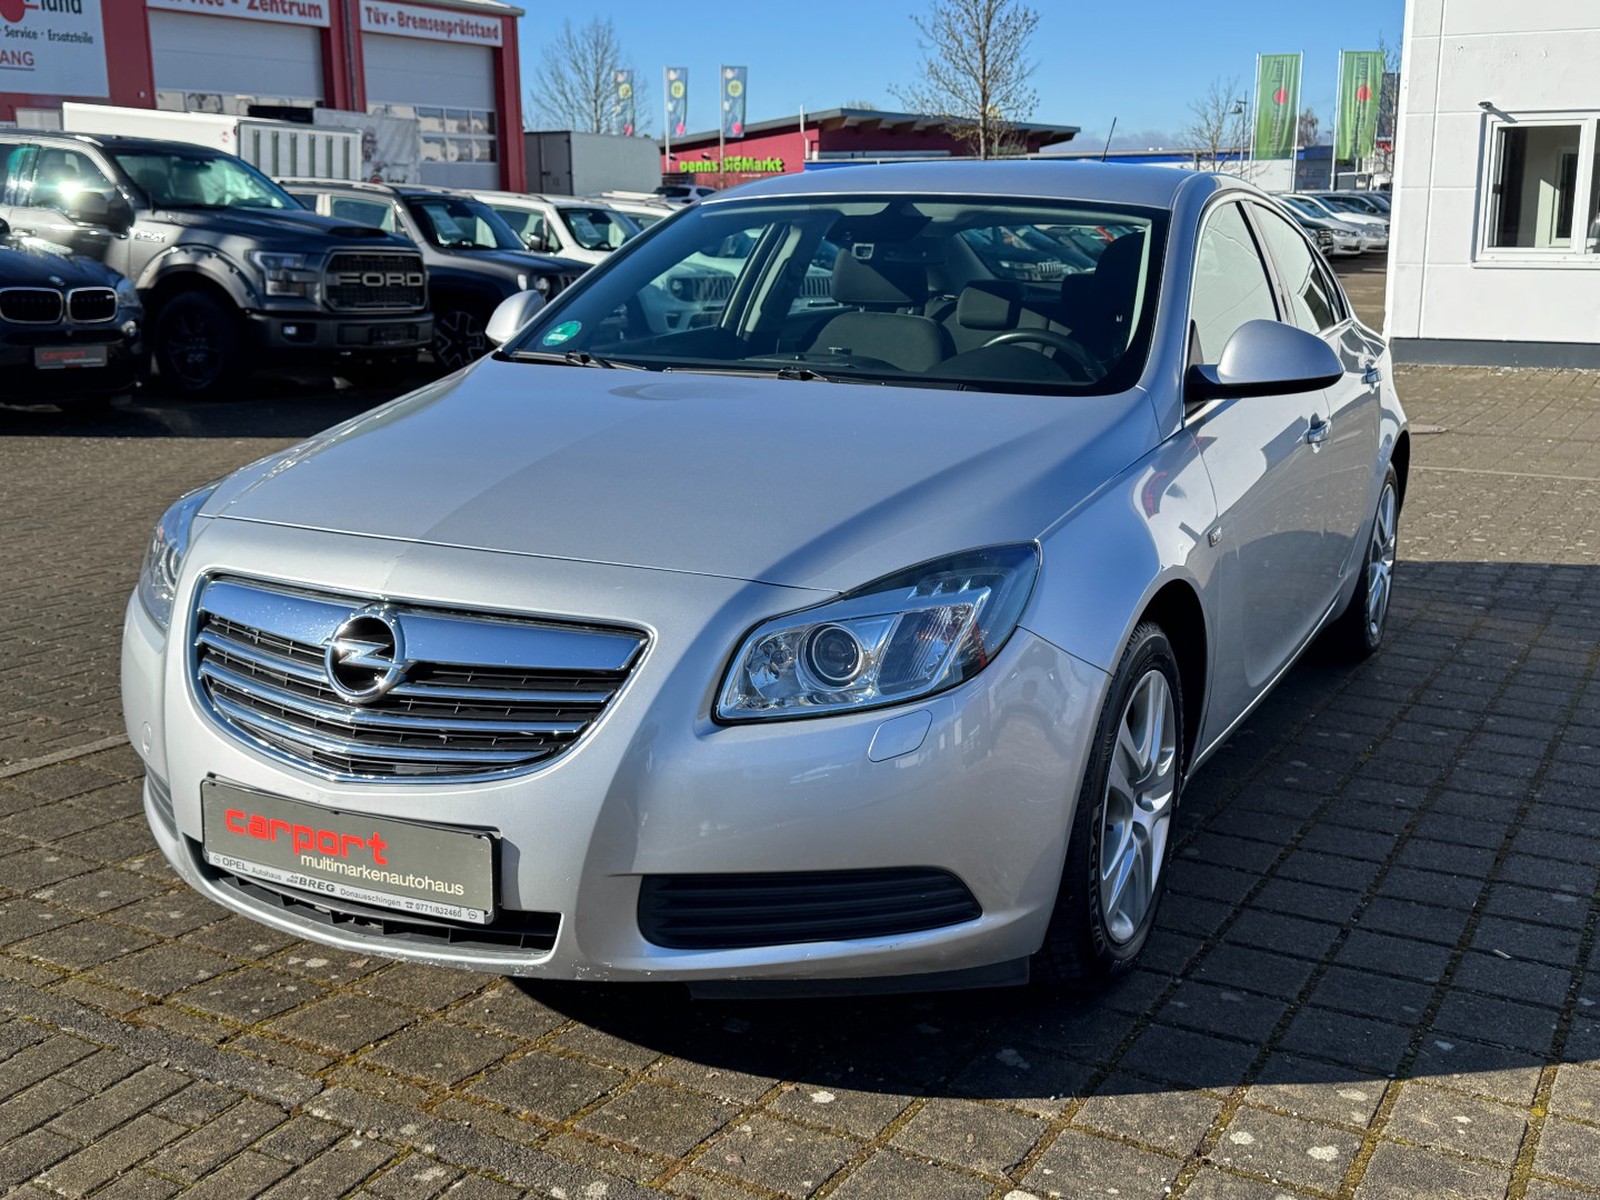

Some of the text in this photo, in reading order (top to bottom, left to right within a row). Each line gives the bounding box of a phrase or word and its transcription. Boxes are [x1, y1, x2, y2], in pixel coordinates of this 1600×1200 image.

[4, 24, 94, 45] Service Ersatzteile
[397, 11, 499, 40] Bremsenprüfstand
[328, 271, 424, 287] FORD
[225, 808, 388, 866] carport
[222, 857, 249, 872] OPEL
[251, 867, 282, 881] Autohaus
[299, 876, 336, 893] BREG
[340, 888, 402, 910] Donaueschingen
[301, 854, 465, 896] multimarkenautohaus
